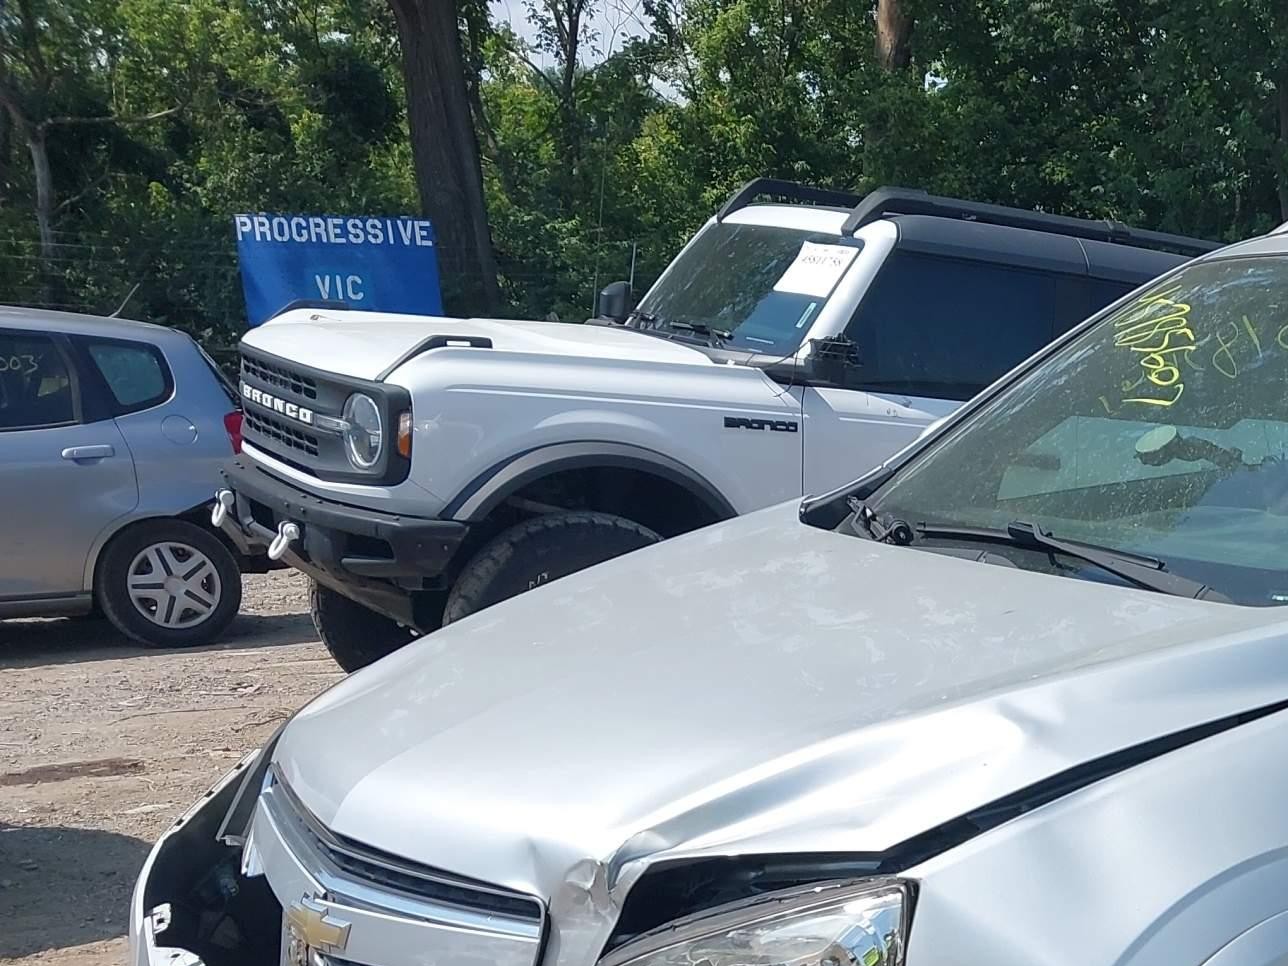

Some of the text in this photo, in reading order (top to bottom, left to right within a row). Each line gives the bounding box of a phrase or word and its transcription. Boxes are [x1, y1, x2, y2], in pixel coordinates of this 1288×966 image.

[234, 215, 433, 247] PROGRESSIVE
[315, 274, 365, 300] VIC
[243, 384, 314, 424] BRONCO
[723, 416, 798, 432] BRONCO
